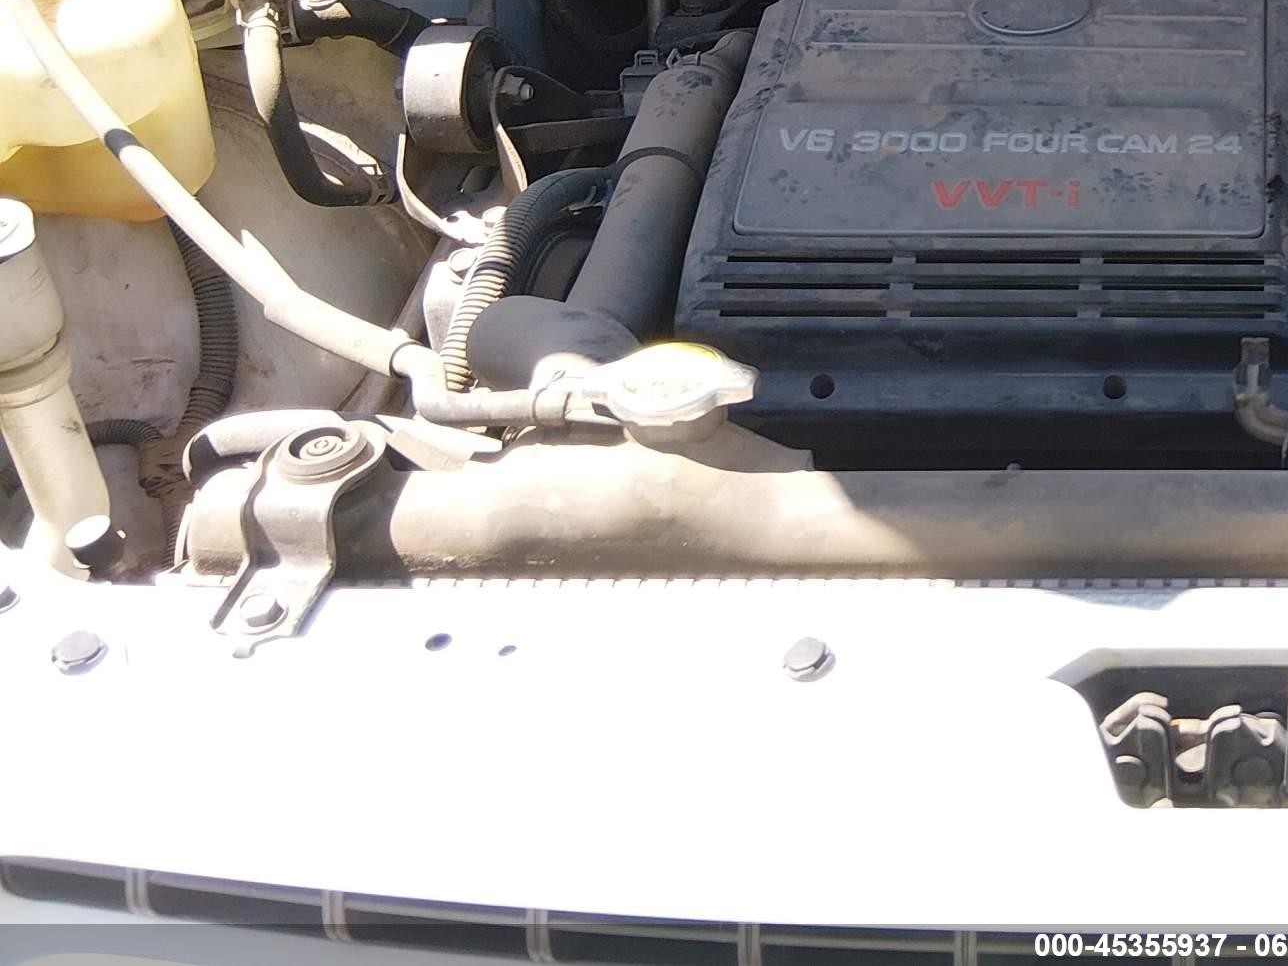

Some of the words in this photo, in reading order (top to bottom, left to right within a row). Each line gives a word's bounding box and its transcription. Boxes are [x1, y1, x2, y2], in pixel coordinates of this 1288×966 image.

[779, 128, 836, 152] V6
[852, 130, 968, 153] 3000
[983, 131, 1089, 154] FOUR
[1096, 132, 1178, 155] CAM
[1188, 134, 1243, 155] 24
[930, 178, 1081, 210] VVT-i
